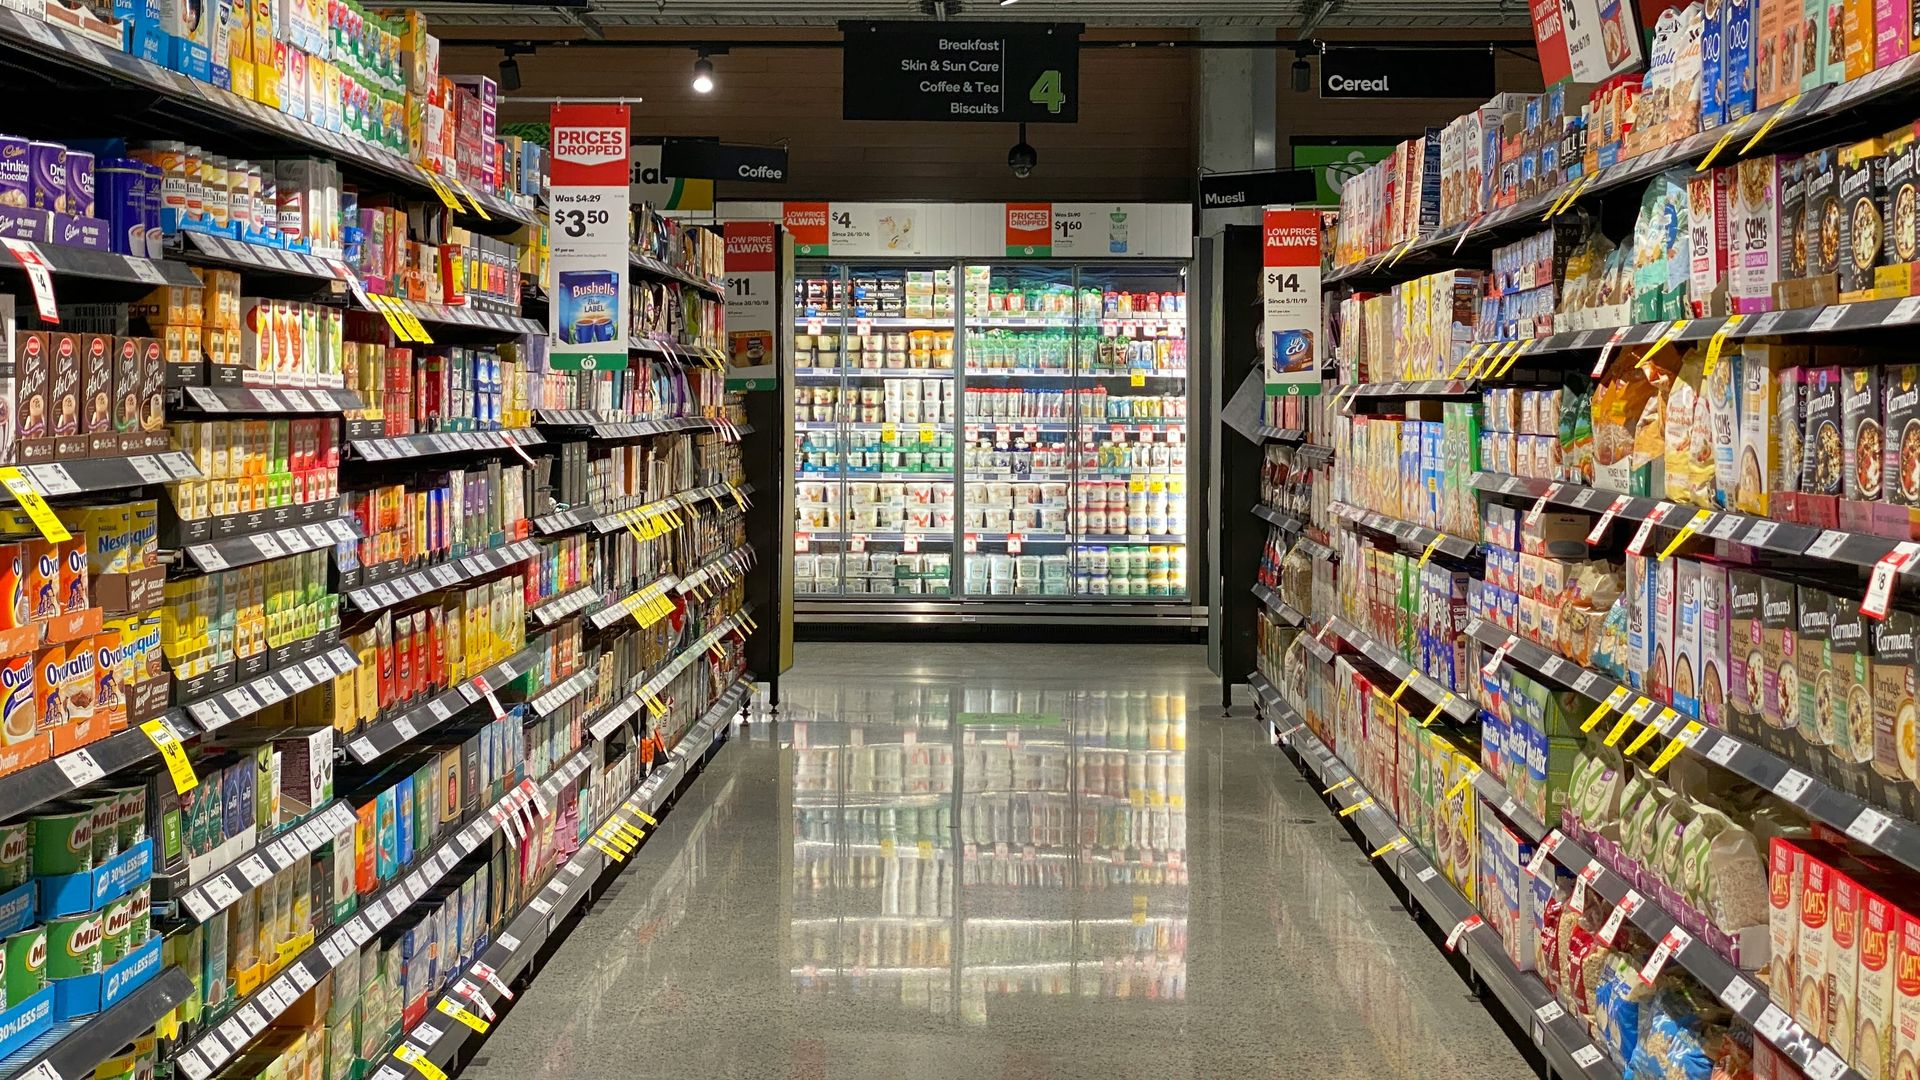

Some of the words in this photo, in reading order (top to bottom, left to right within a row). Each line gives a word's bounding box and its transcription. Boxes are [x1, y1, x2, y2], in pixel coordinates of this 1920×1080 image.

[1537, 12, 1560, 42] ALWAYS
[938, 39, 999, 51] Breakfast
[901, 59, 927, 71] Skin
[930, 60, 939, 72] &
[942, 60, 966, 72] Sun
[968, 60, 999, 72] Care
[919, 80, 960, 93] Coffee
[962, 81, 973, 93] &
[975, 82, 999, 93] Tea
[1029, 70, 1066, 114] 4
[1328, 74, 1390, 92] Cereal
[950, 102, 999, 114] Biscuits
[558, 130, 622, 144] PRICES
[558, 146, 622, 156] DROPPED
[738, 164, 782, 179] Coffee
[1884, 145, 1914, 186] Carman's
[1807, 164, 1834, 197] Carman's
[1840, 160, 1869, 198] Carman's
[555, 194, 574, 202] Was
[576, 194, 600, 202] $4.29
[1205, 191, 1245, 204] Muesli
[786, 218, 826, 226] ALWAYS
[832, 212, 852, 228] $4
[1011, 212, 1047, 220] PRICES
[726, 236, 746, 244] LOW
[1267, 228, 1289, 236] LOW
[1290, 228, 1317, 236] PRICE
[726, 244, 773, 254] ALWAYS
[1267, 236, 1318, 247] ALWAYS
[572, 282, 615, 298] Bushells
[728, 278, 750, 296] $11
[1268, 273, 1300, 293] $14
[584, 304, 604, 313] LABEL
[1843, 385, 1871, 414] Carman's
[1887, 384, 1918, 414] Carman's
[1614, 479, 1629, 488] CRUNCH
[1878, 573, 1886, 590] $8
[1732, 585, 1758, 609] Carman's
[1763, 592, 1790, 617] Carman's
[1830, 614, 1861, 640] Carman's
[1482, 720, 1499, 746] Weet-Bix
[1509, 724, 1527, 759] Weet-Bix
[1527, 740, 1546, 775] Weet-Bix
[123, 859, 138, 876] LESS
[1810, 862, 1824, 880] UNCLE
[1772, 871, 1788, 896] OATS
[1804, 888, 1825, 915] OATS
[1869, 897, 1885, 918] UNCLE
[1834, 906, 1853, 934] OATS
[1863, 927, 1885, 955] OATS
[121, 968, 133, 985] 30%
[133, 958, 150, 978] LESS
[16, 1005, 36, 1030] LESS
